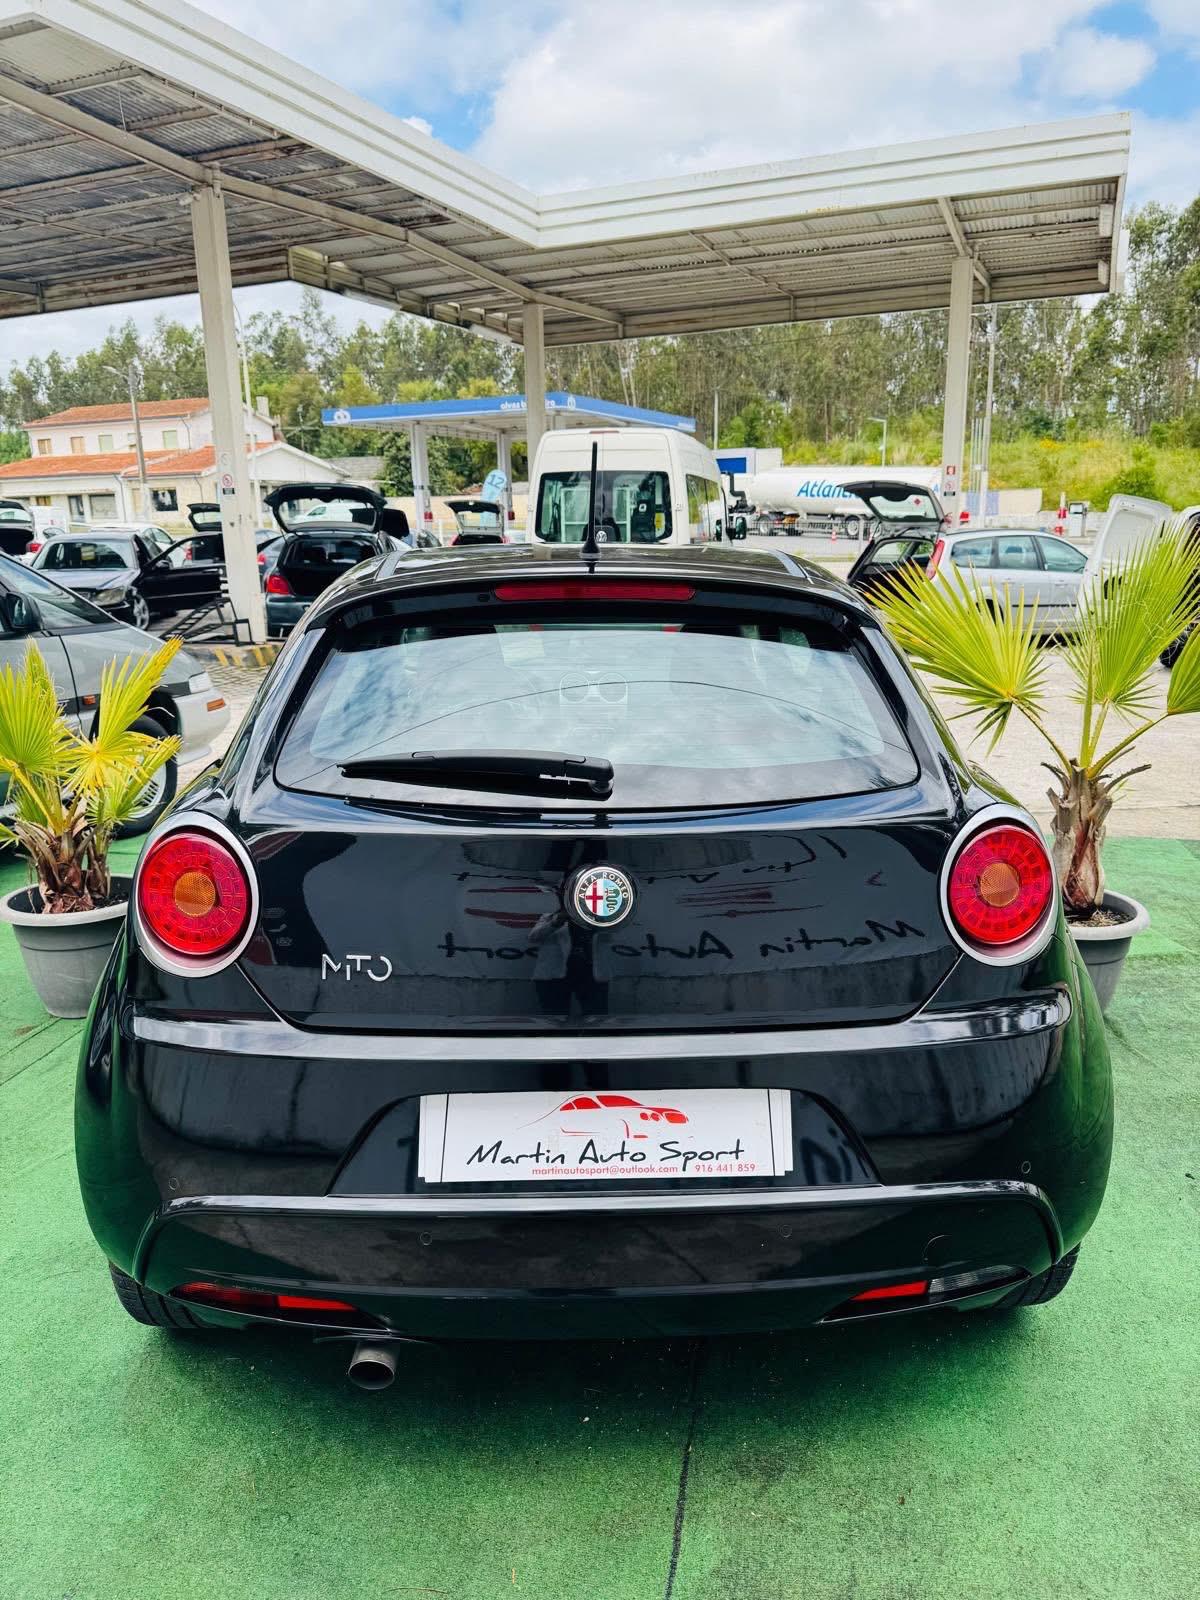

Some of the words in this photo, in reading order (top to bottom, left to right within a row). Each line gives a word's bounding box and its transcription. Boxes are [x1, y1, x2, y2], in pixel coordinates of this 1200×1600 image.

[579, 874, 597, 899] ALFA
[602, 872, 629, 899] ROMEO
[466, 1139, 566, 1166] Martin
[578, 1138, 647, 1165] Auto
[659, 1138, 745, 1172] Sport
[532, 1165, 679, 1176] martinautosport@outlook.com
[694, 1163, 714, 1174] 916
[715, 1163, 733, 1174] 441
[737, 1162, 756, 1173] 859
